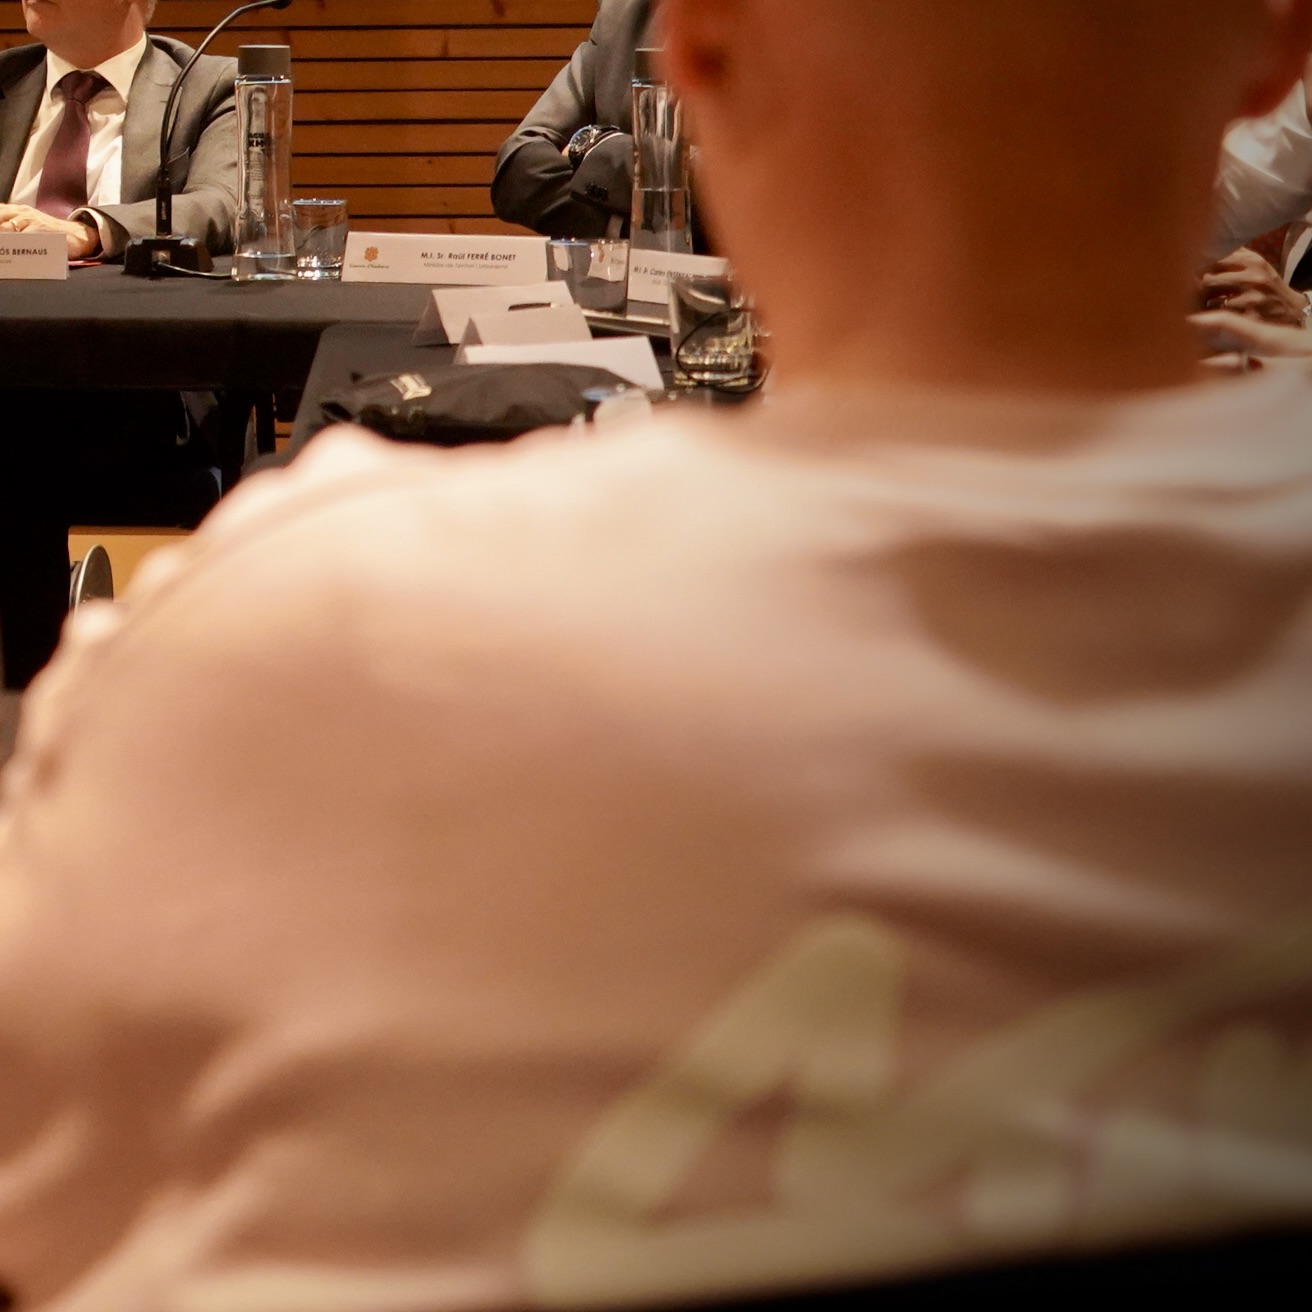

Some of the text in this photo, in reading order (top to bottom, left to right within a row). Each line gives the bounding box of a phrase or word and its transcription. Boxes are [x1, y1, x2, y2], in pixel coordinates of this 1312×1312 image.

[12, 248, 48, 256] BERNAUS
[448, 252, 465, 260] Raül
[467, 251, 489, 261] FERRÉ
[491, 253, 516, 261] BONET
